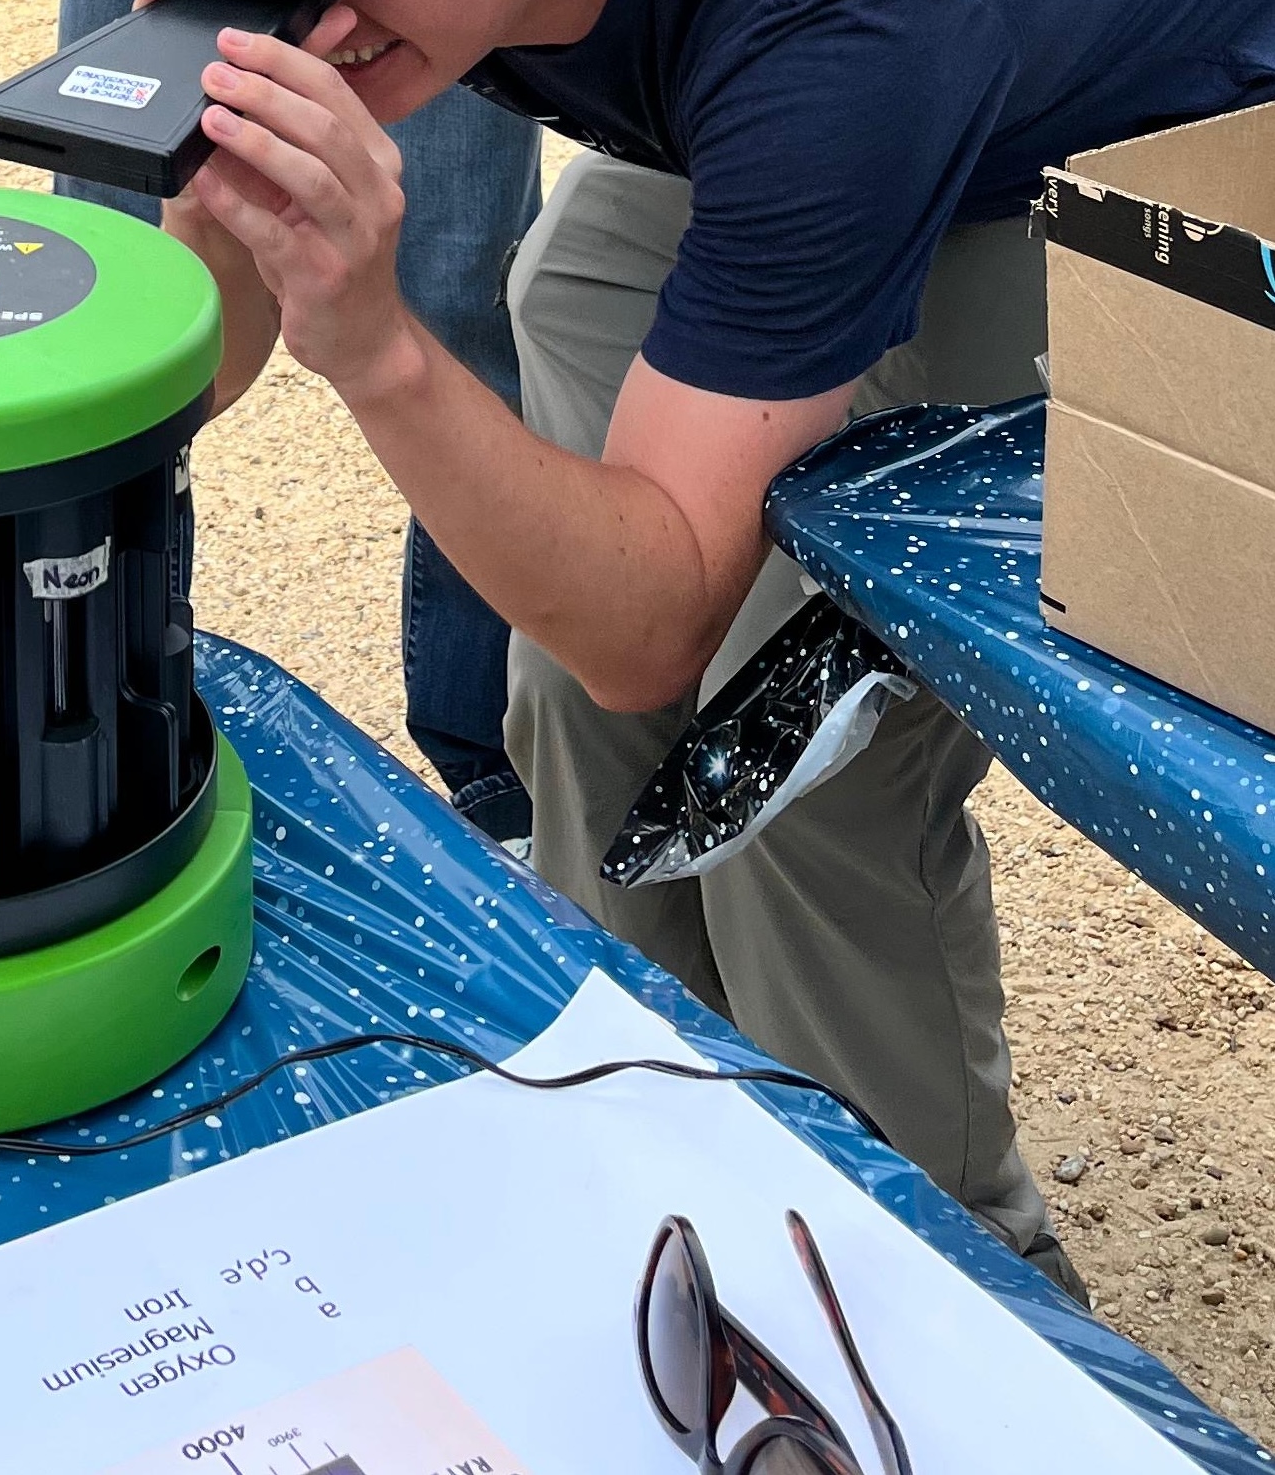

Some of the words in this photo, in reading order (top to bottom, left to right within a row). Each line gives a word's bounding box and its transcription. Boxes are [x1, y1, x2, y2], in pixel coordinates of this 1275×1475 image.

[1142, 207, 1152, 239] songs
[42, 563, 101, 590] Neon
[219, 1248, 292, 1285] c,d,e
[294, 1274, 323, 1295] b
[123, 1287, 193, 1322] Iron
[317, 1300, 342, 1319] a
[41, 1315, 215, 1392] Magnesium
[118, 1343, 237, 1397] Oxygen
[181, 1423, 246, 1461] 4000
[267, 1426, 303, 1448] 3900
